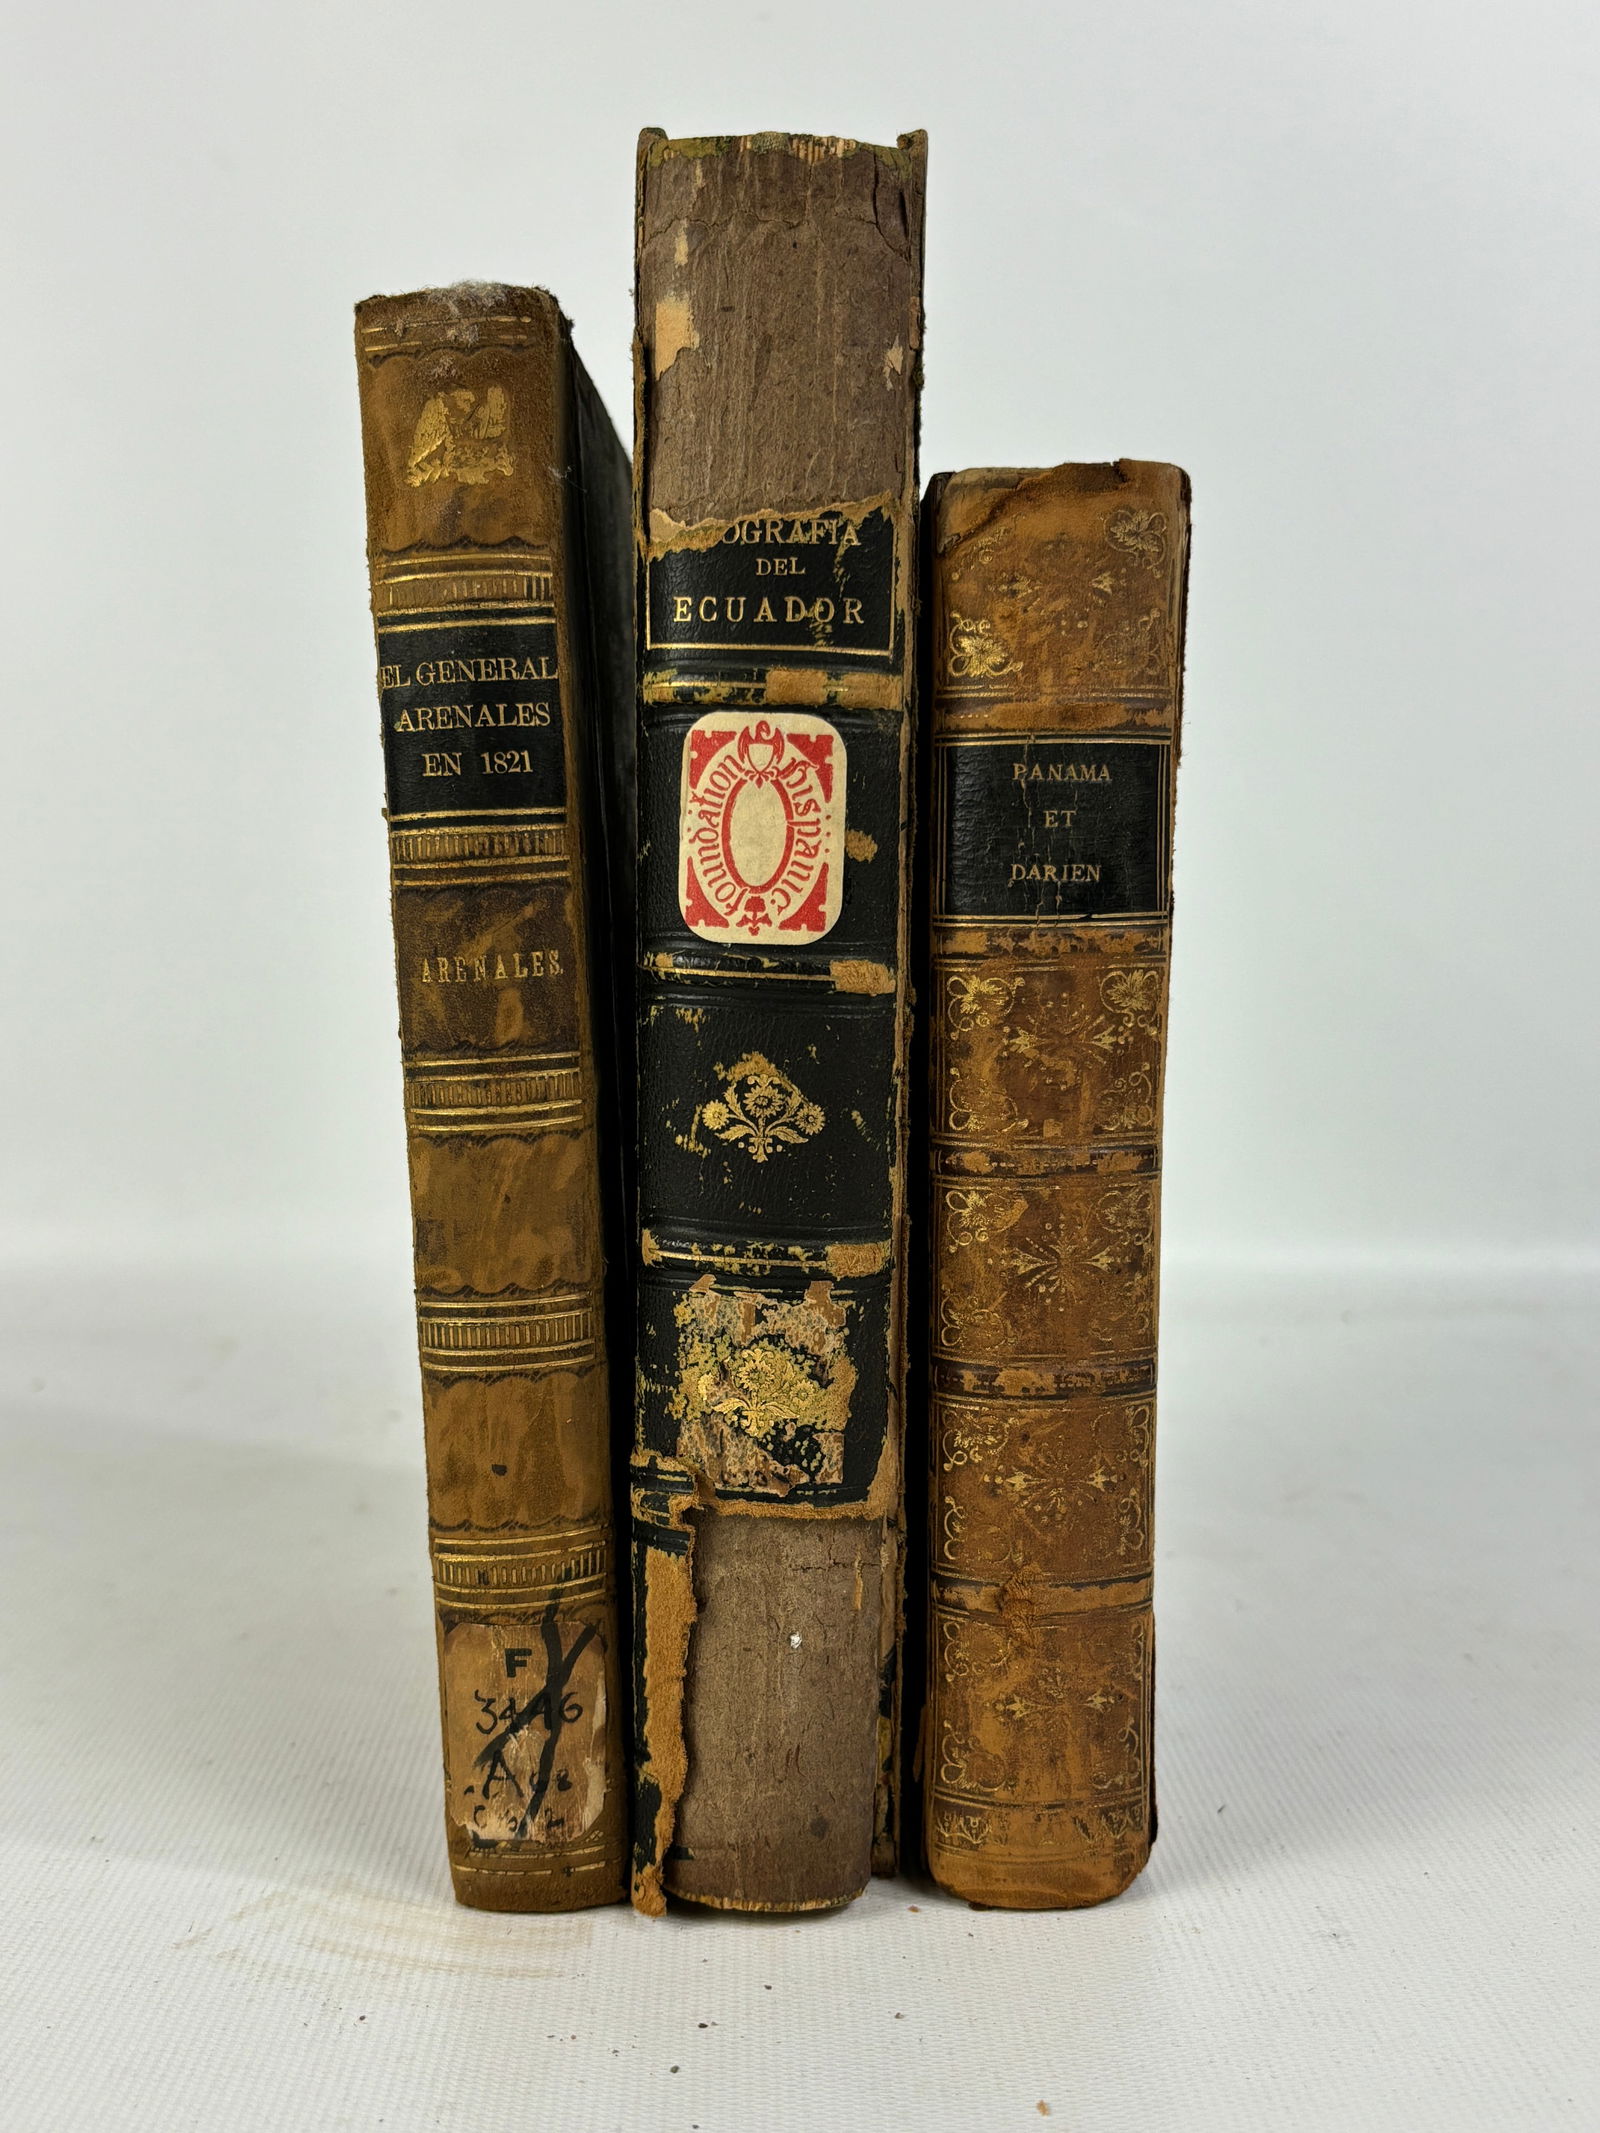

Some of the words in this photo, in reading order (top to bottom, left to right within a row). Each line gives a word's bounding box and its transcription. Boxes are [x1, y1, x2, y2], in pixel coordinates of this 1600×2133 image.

[755, 556, 806, 576] DEL
[673, 596, 865, 625] ECUADOR
[380, 665, 411, 689] EL
[416, 656, 559, 686] GENERAL
[396, 702, 551, 732] ARENALES
[422, 753, 463, 777] EN
[482, 750, 534, 775] 1821
[1012, 762, 1113, 782] PANAMA
[1043, 809, 1077, 828] ET
[1011, 863, 1102, 883] DARIEN
[504, 1648, 532, 1678] F
